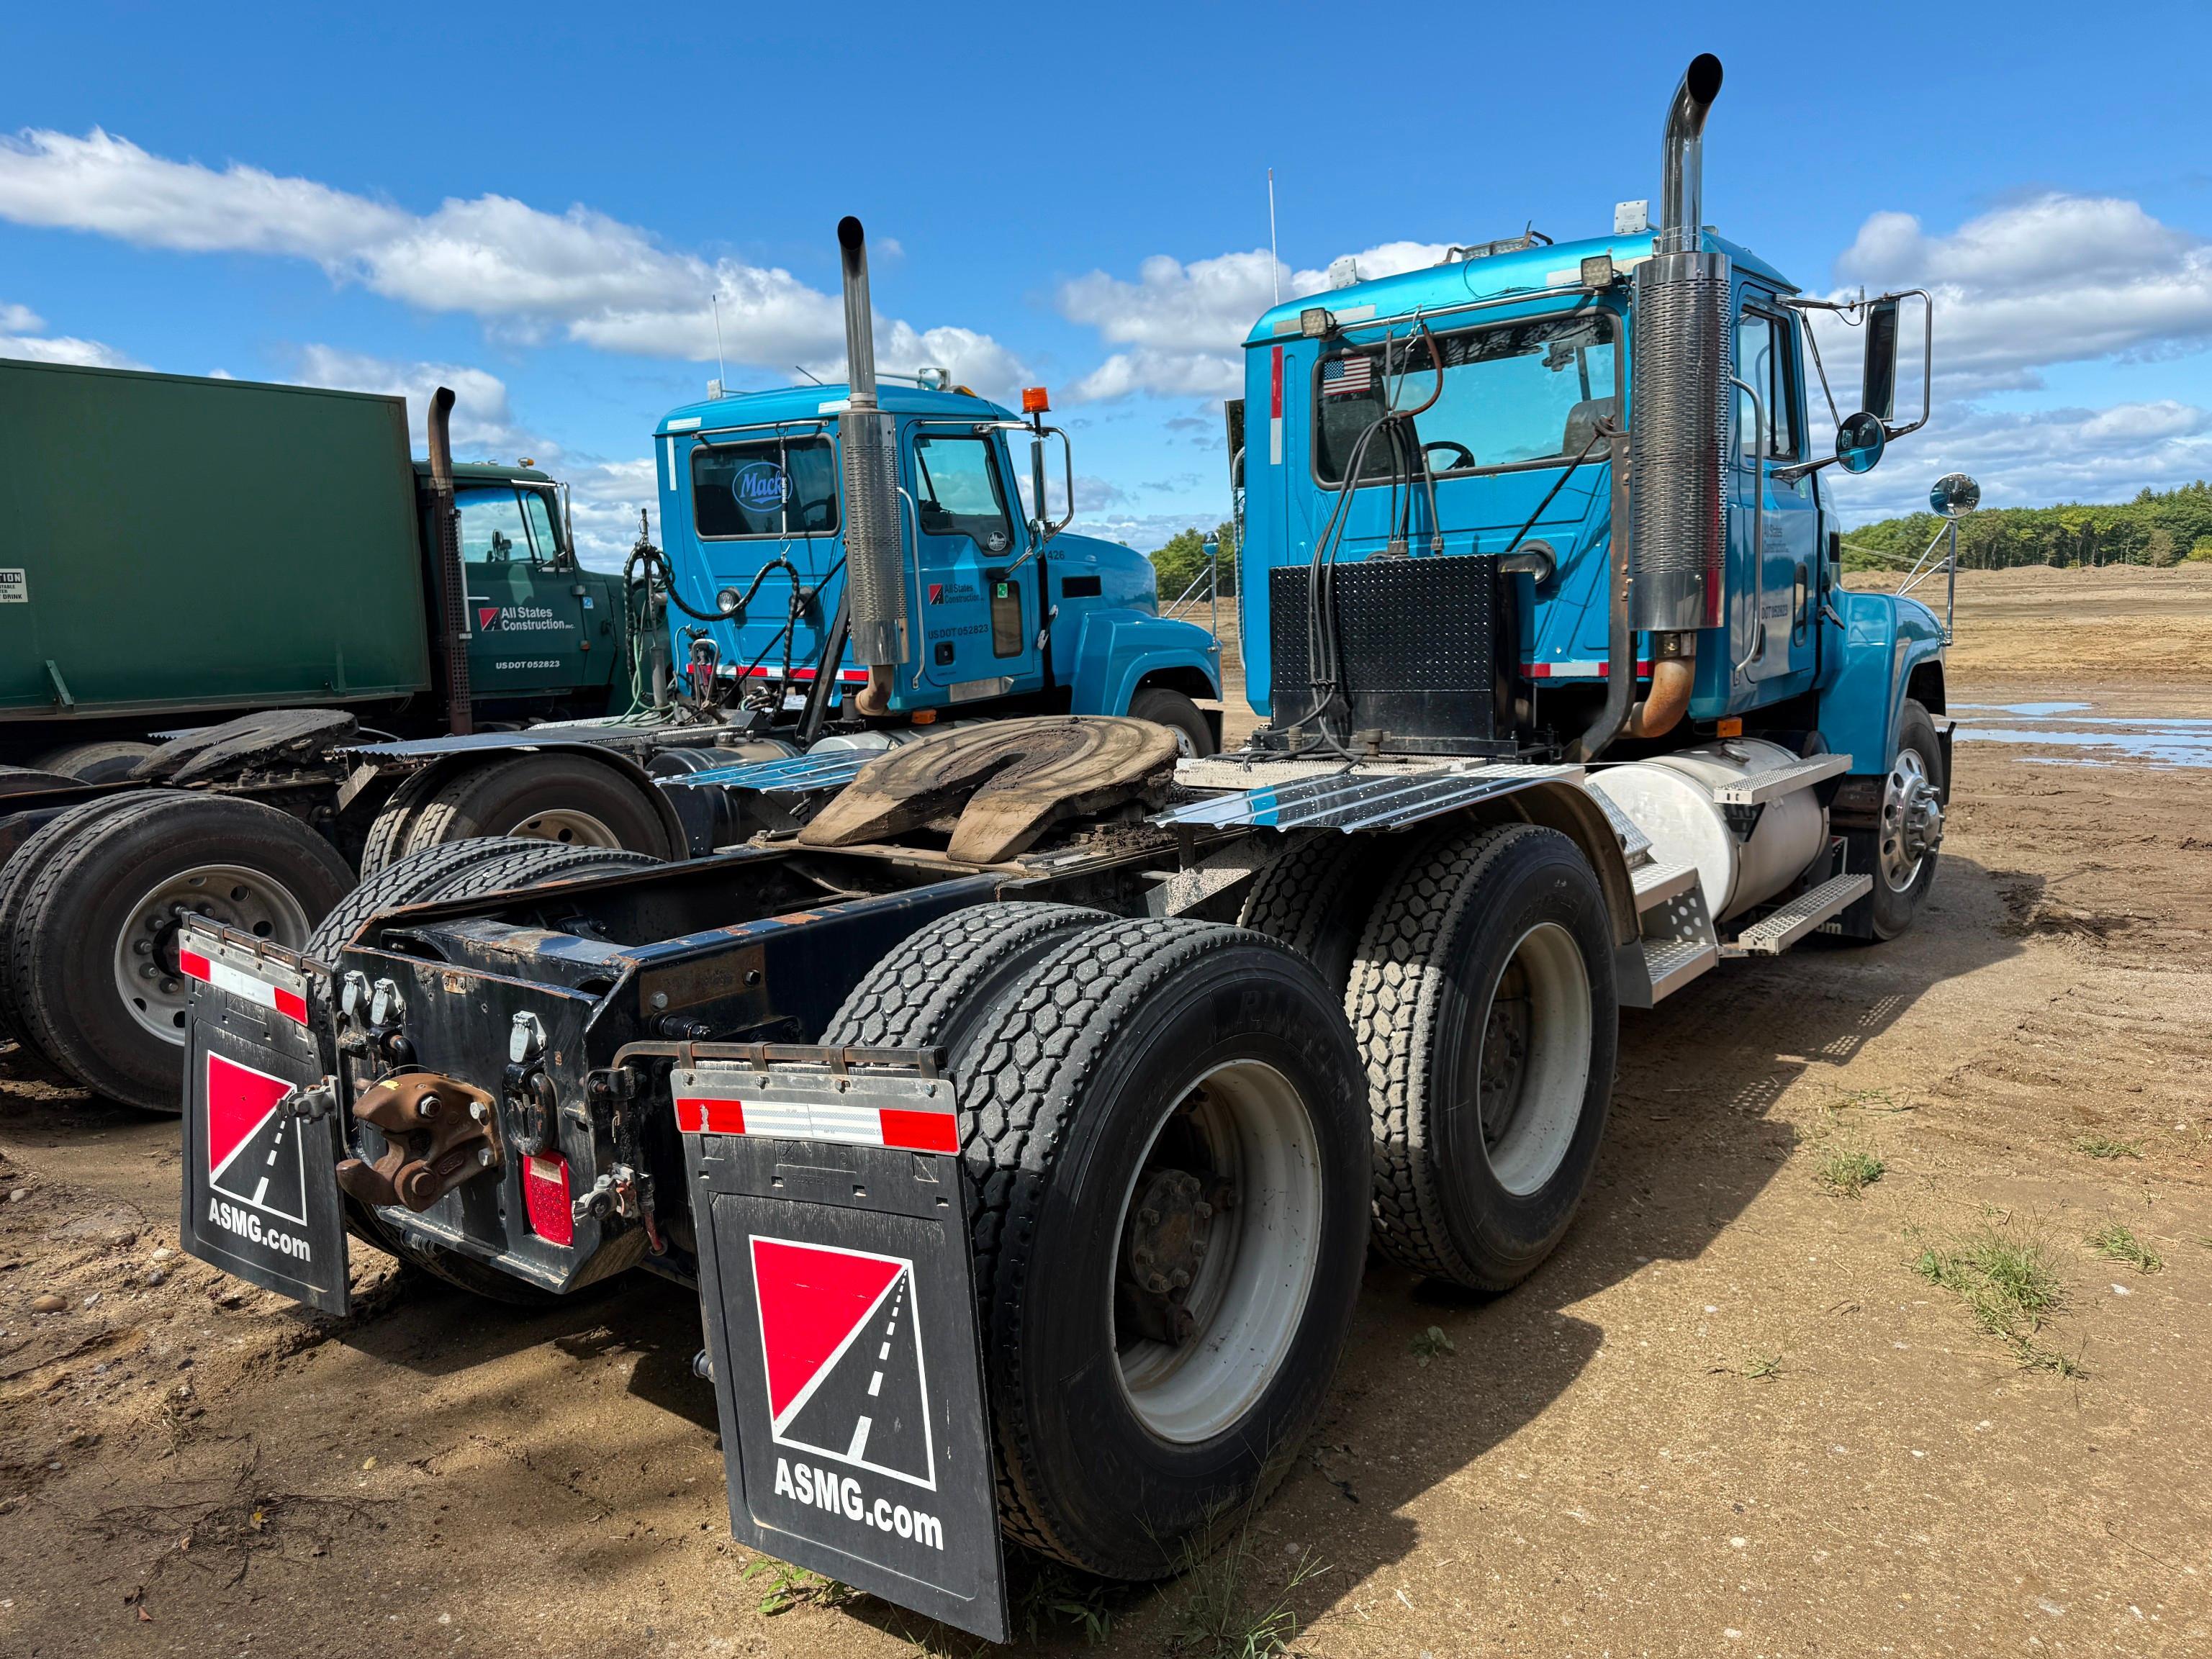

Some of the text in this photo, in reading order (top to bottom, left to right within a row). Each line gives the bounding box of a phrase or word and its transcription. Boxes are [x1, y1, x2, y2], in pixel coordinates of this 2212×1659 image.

[739, 470, 782, 498] Mack
[1047, 550, 1065, 560] 426
[954, 583, 974, 593] States
[501, 606, 554, 619] All States
[502, 618, 565, 631] Construction
[208, 1197, 311, 1262] ASMG.com
[774, 1457, 944, 1551] ASMG.com
